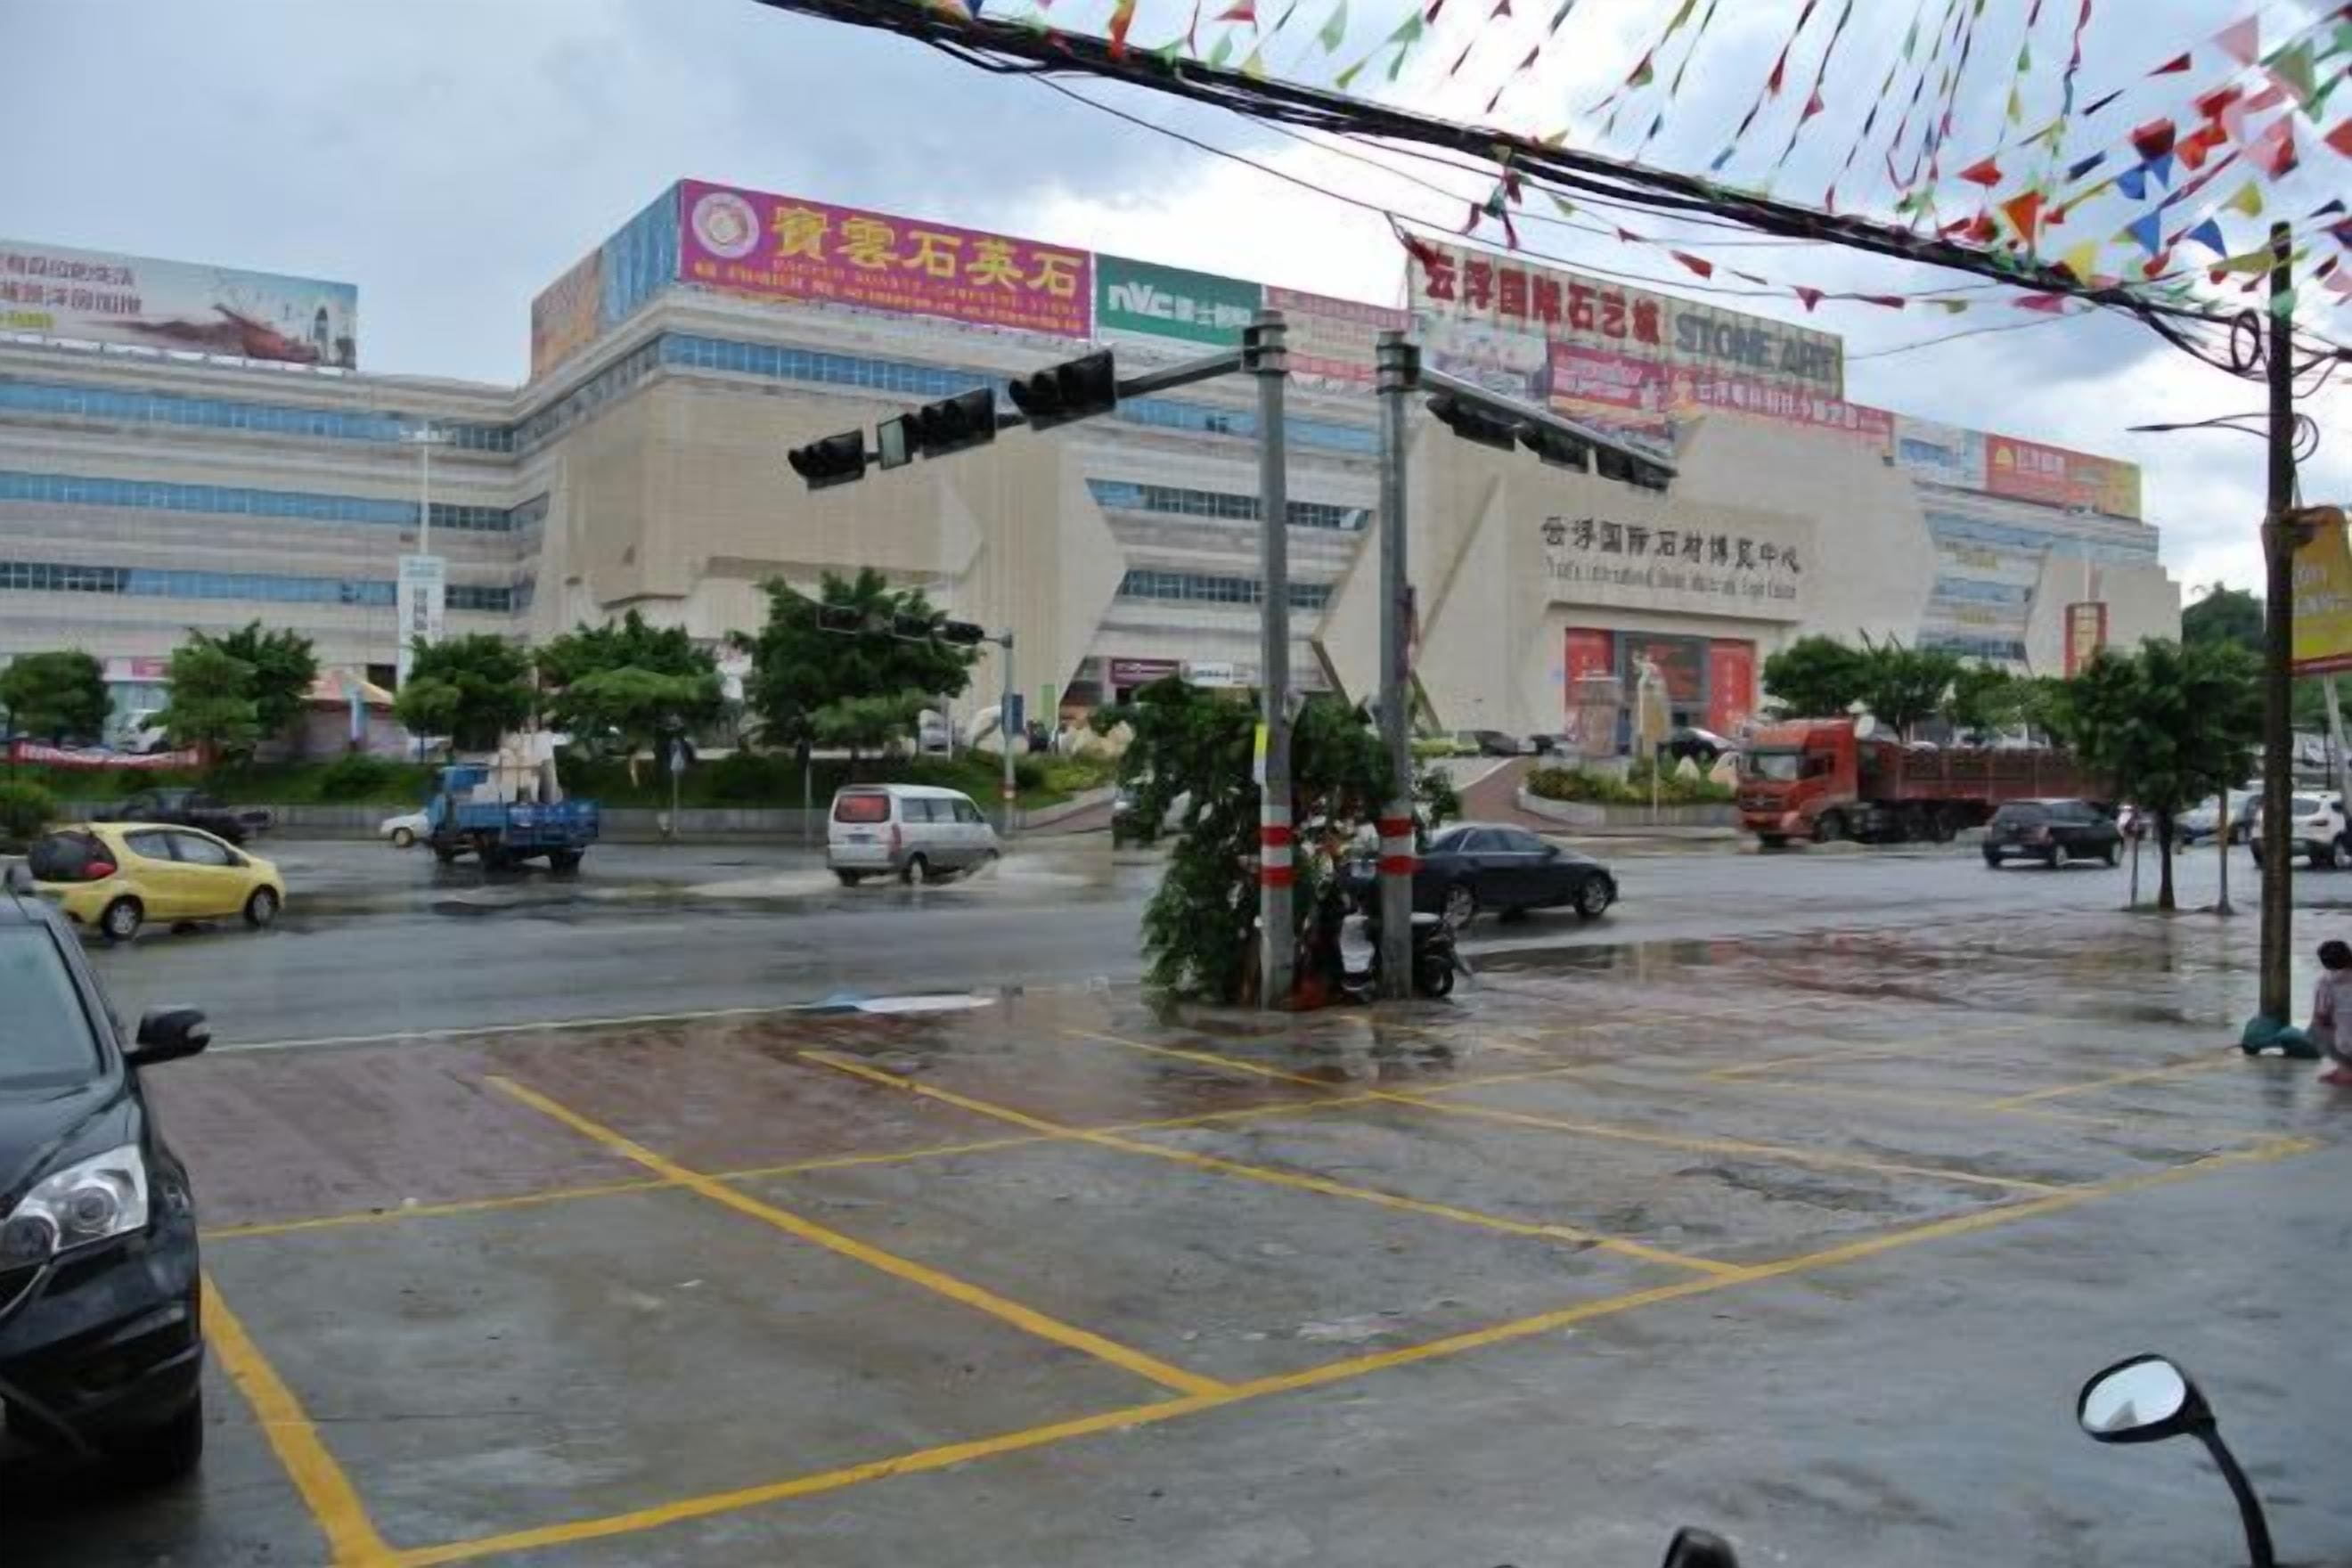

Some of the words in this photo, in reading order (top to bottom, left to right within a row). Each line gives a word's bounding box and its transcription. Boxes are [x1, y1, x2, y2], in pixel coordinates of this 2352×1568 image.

[1675, 312, 1771, 368] STONE
[1779, 339, 1834, 383] ART
[1541, 516, 1801, 574] 云浮国际石材博览中心
